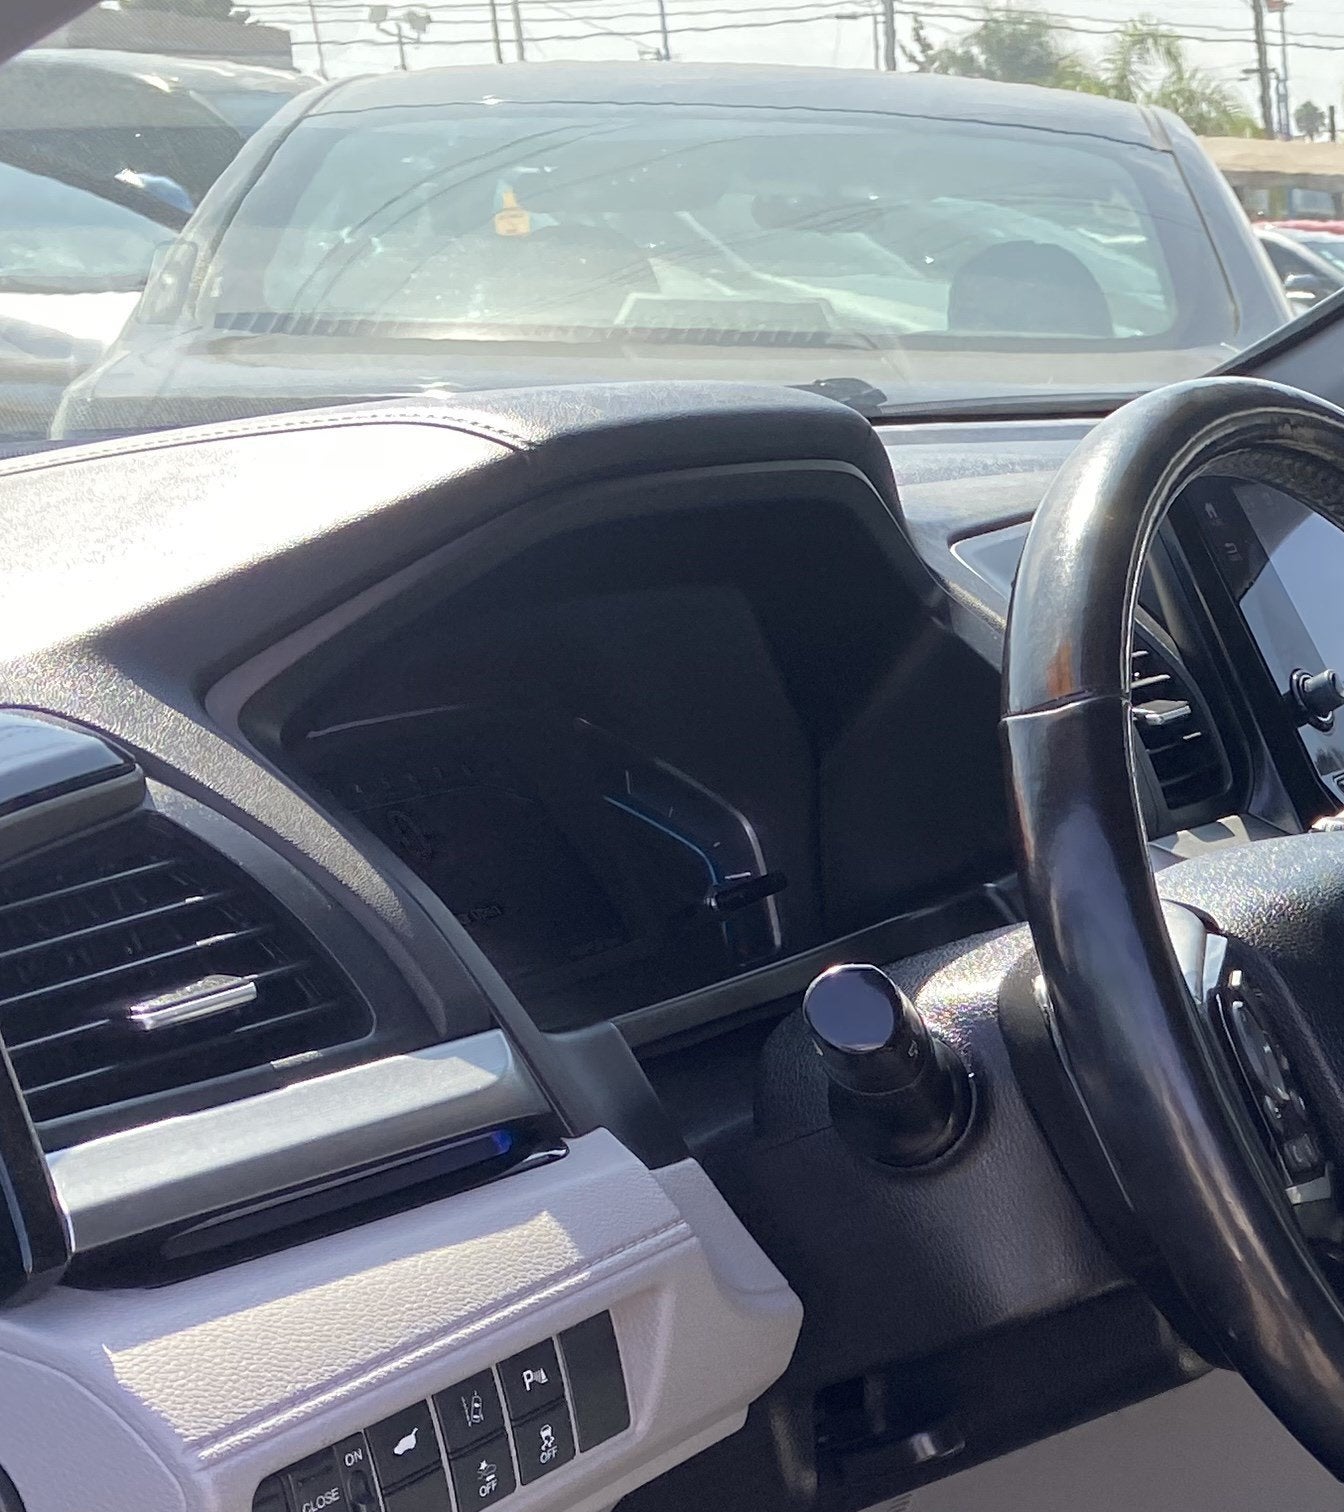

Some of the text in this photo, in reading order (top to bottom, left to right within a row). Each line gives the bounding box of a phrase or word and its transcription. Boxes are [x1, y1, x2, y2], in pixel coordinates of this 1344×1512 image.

[344, 1448, 363, 1467] ON
[540, 1445, 558, 1464] OFF
[479, 1478, 498, 1498] OFF
